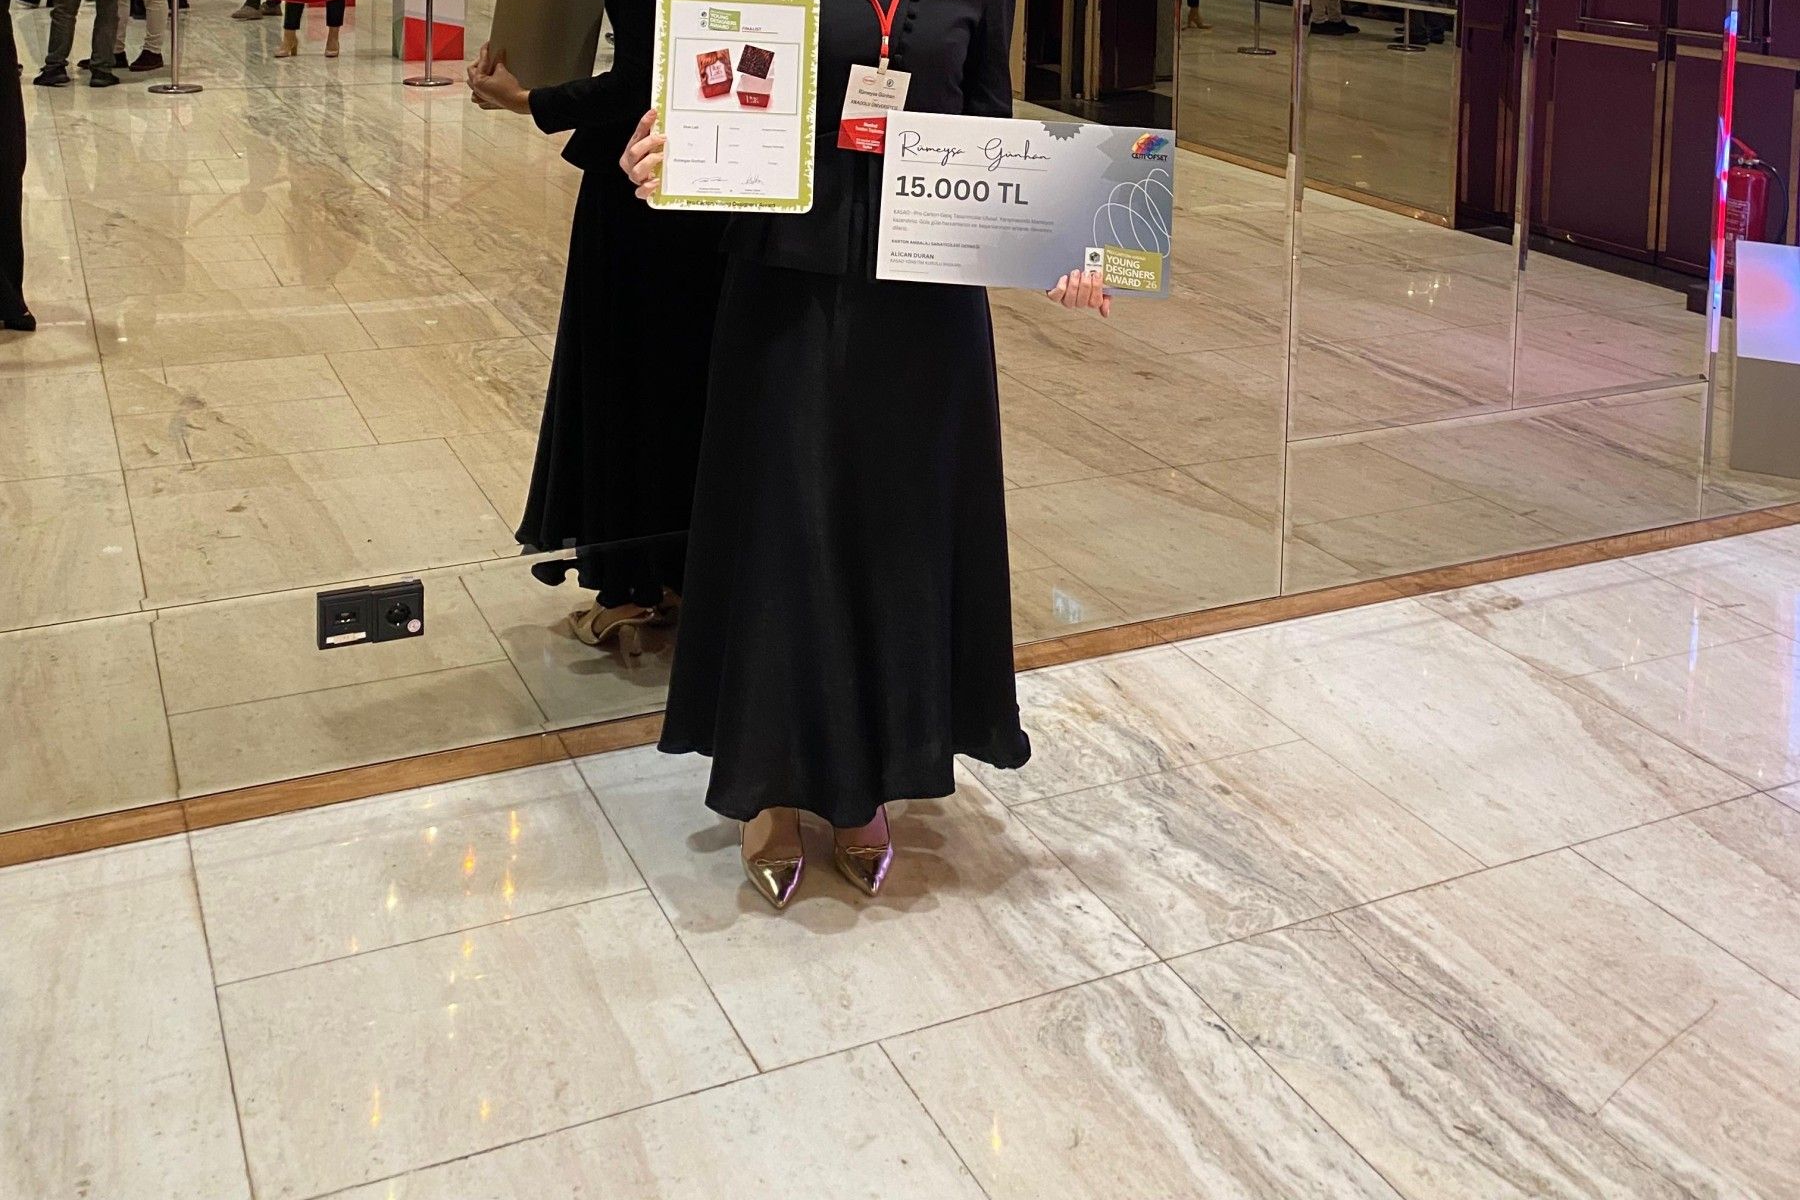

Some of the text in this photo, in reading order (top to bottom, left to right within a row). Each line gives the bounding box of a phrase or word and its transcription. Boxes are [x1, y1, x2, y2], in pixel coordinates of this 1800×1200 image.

[895, 175, 1029, 205] 15.000 TL
[1106, 254, 1140, 269] YOUNG
[1105, 263, 1155, 280] DESIGNERS
[1105, 274, 1142, 288] AWARD
